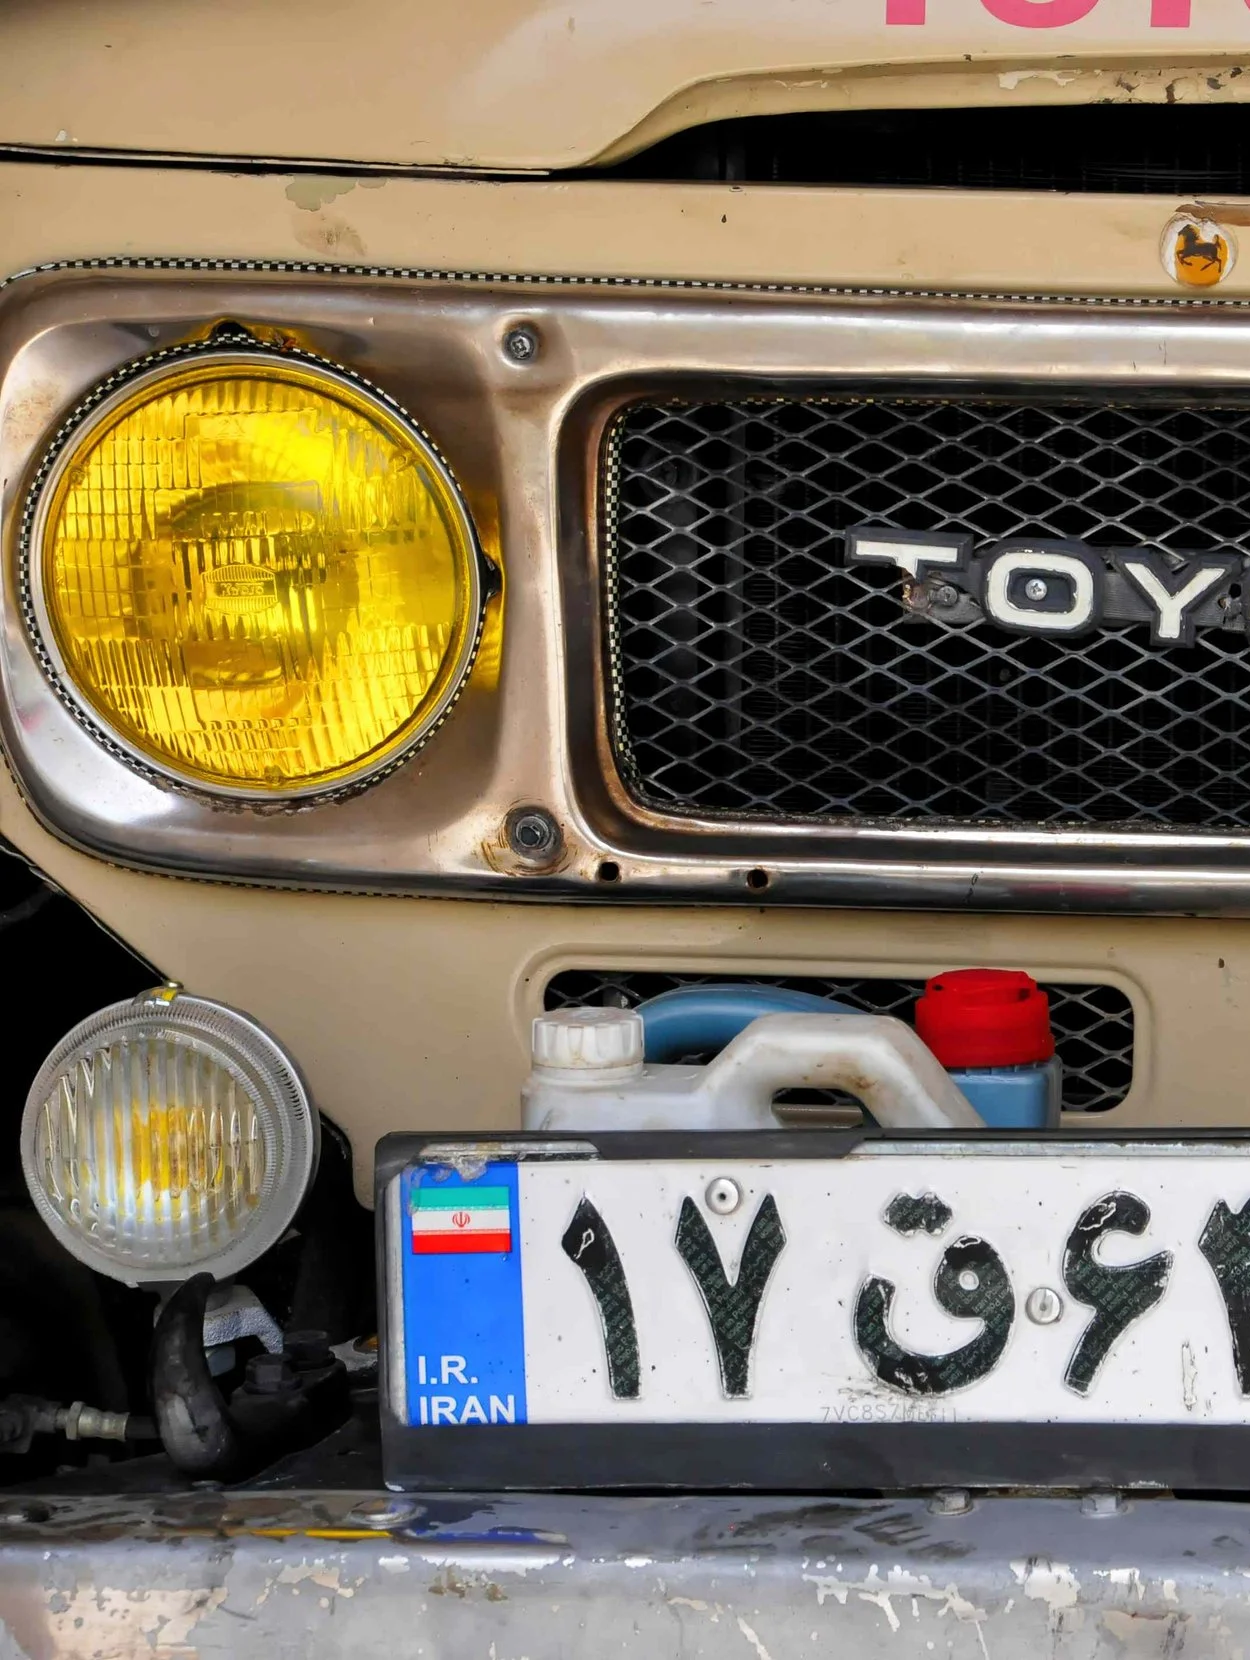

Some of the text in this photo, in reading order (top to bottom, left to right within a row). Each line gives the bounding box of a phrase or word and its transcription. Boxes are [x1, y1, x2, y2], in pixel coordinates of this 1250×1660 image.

[562, 1192, 787, 1400] ۱۷
[418, 1355, 478, 1385] I.R.
[420, 1394, 516, 1425] IRAN
